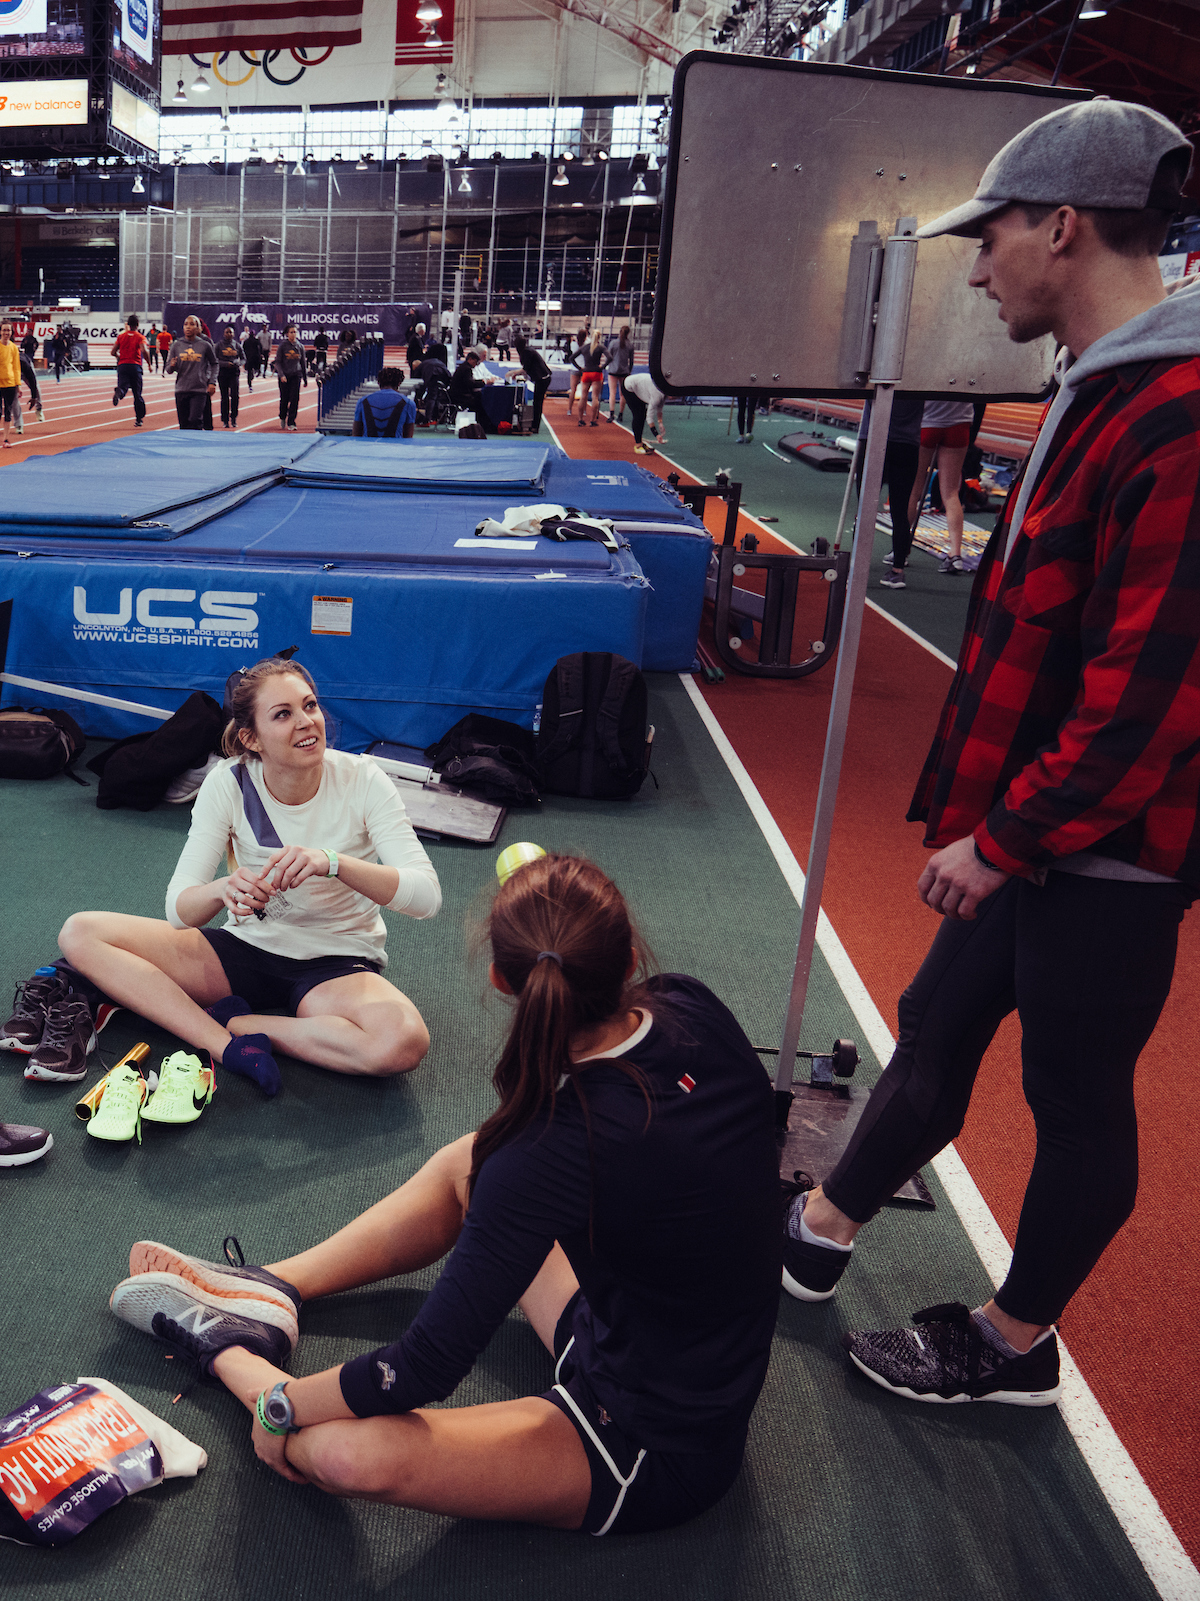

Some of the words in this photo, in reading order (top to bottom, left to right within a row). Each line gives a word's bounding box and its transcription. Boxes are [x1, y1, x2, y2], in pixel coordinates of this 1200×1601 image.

[10, 102, 33, 111] new
[35, 99, 82, 110] balance
[62, 226, 94, 236] Berkeley
[287, 313, 340, 324] MILLROSE
[341, 313, 379, 324] GAMES
[300, 330, 340, 341] ARMRY
[73, 586, 259, 631] UCS
[73, 624, 131, 633] LINCOLNTON,
[73, 630, 259, 649] WWW.UCSSPIRIT.COM
[22, 1398, 140, 1484] TRACKSMITH
[65, 1472, 114, 1507] MILLROSE
[37, 1495, 81, 1533] GAMES
